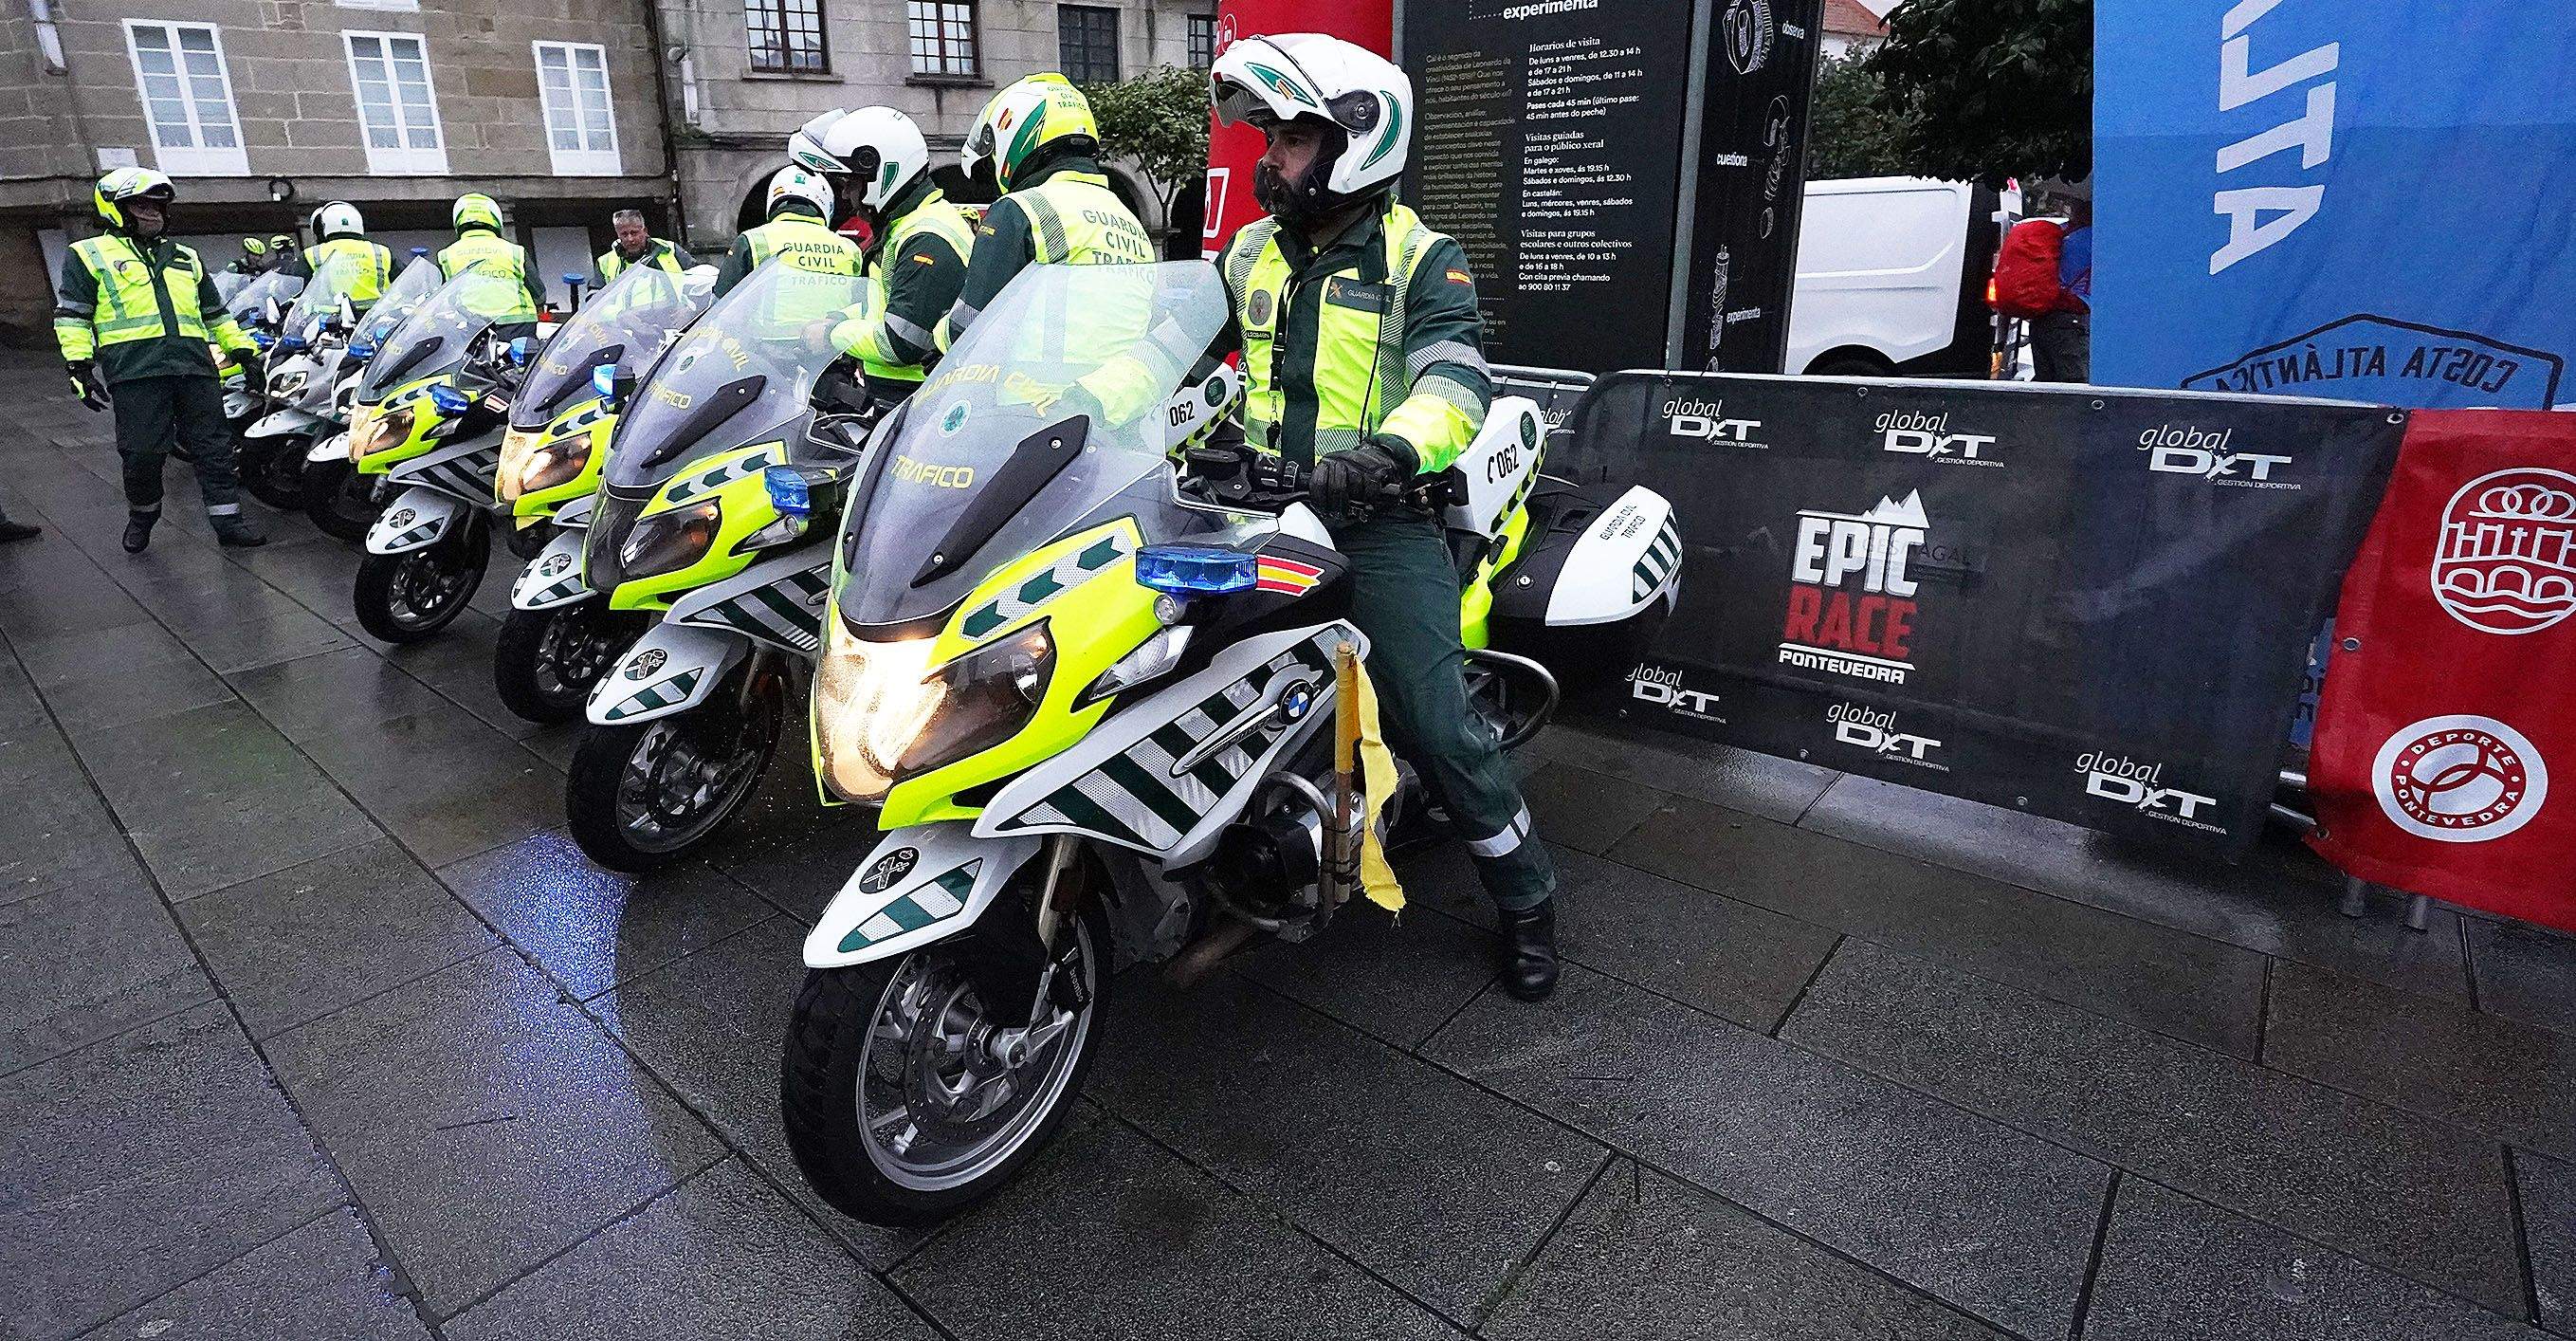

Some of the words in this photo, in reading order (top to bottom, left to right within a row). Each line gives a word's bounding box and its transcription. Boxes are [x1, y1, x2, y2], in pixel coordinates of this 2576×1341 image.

[1503, 0, 1599, 20] experimenta
[1528, 42, 1564, 53] Horarios
[1566, 40, 1576, 48] de
[1578, 36, 1600, 46] visita
[1562, 53, 1587, 63] venres,
[1528, 78, 1557, 87] Sábados
[1564, 74, 1600, 83] domingos,
[1593, 97, 1617, 105] (último
[1619, 95, 1639, 104] pase:
[1581, 106, 1606, 118] peche)
[1525, 133, 1551, 142] Visitas
[1553, 131, 1584, 141] guiadas
[1525, 145, 1543, 154] para
[1551, 140, 1581, 152] público
[1582, 139, 1604, 148] xeral
[1534, 156, 1559, 165] galego:
[1587, 164, 1602, 173] 19.15
[1523, 176, 1551, 185] Sábados
[1559, 175, 1595, 184] domingos,
[1532, 189, 1562, 197] castelán:
[1083, 210, 1150, 245] GUARDIA
[1547, 230, 1566, 239] para
[1566, 230, 1595, 239] grupos
[783, 242, 846, 255] GUARDIA
[1105, 231, 1145, 258] CIVIL
[1591, 240, 1633, 248] colectivos
[798, 256, 835, 267] CIVIL
[1549, 273, 1570, 282] previa
[1348, 289, 1375, 300] GUARDIA
[1170, 400, 1195, 427] 062
[1662, 396, 1722, 419] global
[1873, 409, 1947, 433] global
[2137, 424, 2232, 451] global
[1496, 444, 1519, 479] 062
[1966, 459, 2004, 468] DEPORTIVA
[891, 454, 975, 488] TRAFICO
[2255, 481, 2302, 491] DEPORTIVA
[1792, 516, 1925, 597] EPIC
[1784, 584, 1917, 658] RACE
[1779, 650, 1906, 685] PONTEVEDRA
[1285, 685, 1310, 706] BMW
[1826, 702, 1896, 729] global
[2410, 732, 2516, 766] DEPORTE
[1913, 759, 1949, 772] DEPORTIVA
[2074, 751, 2162, 783] global
[2395, 775, 2519, 825] PONTEVEDRA
[2182, 818, 2227, 835] DEPORTIVA
[1069, 967, 1084, 1001] brembo
